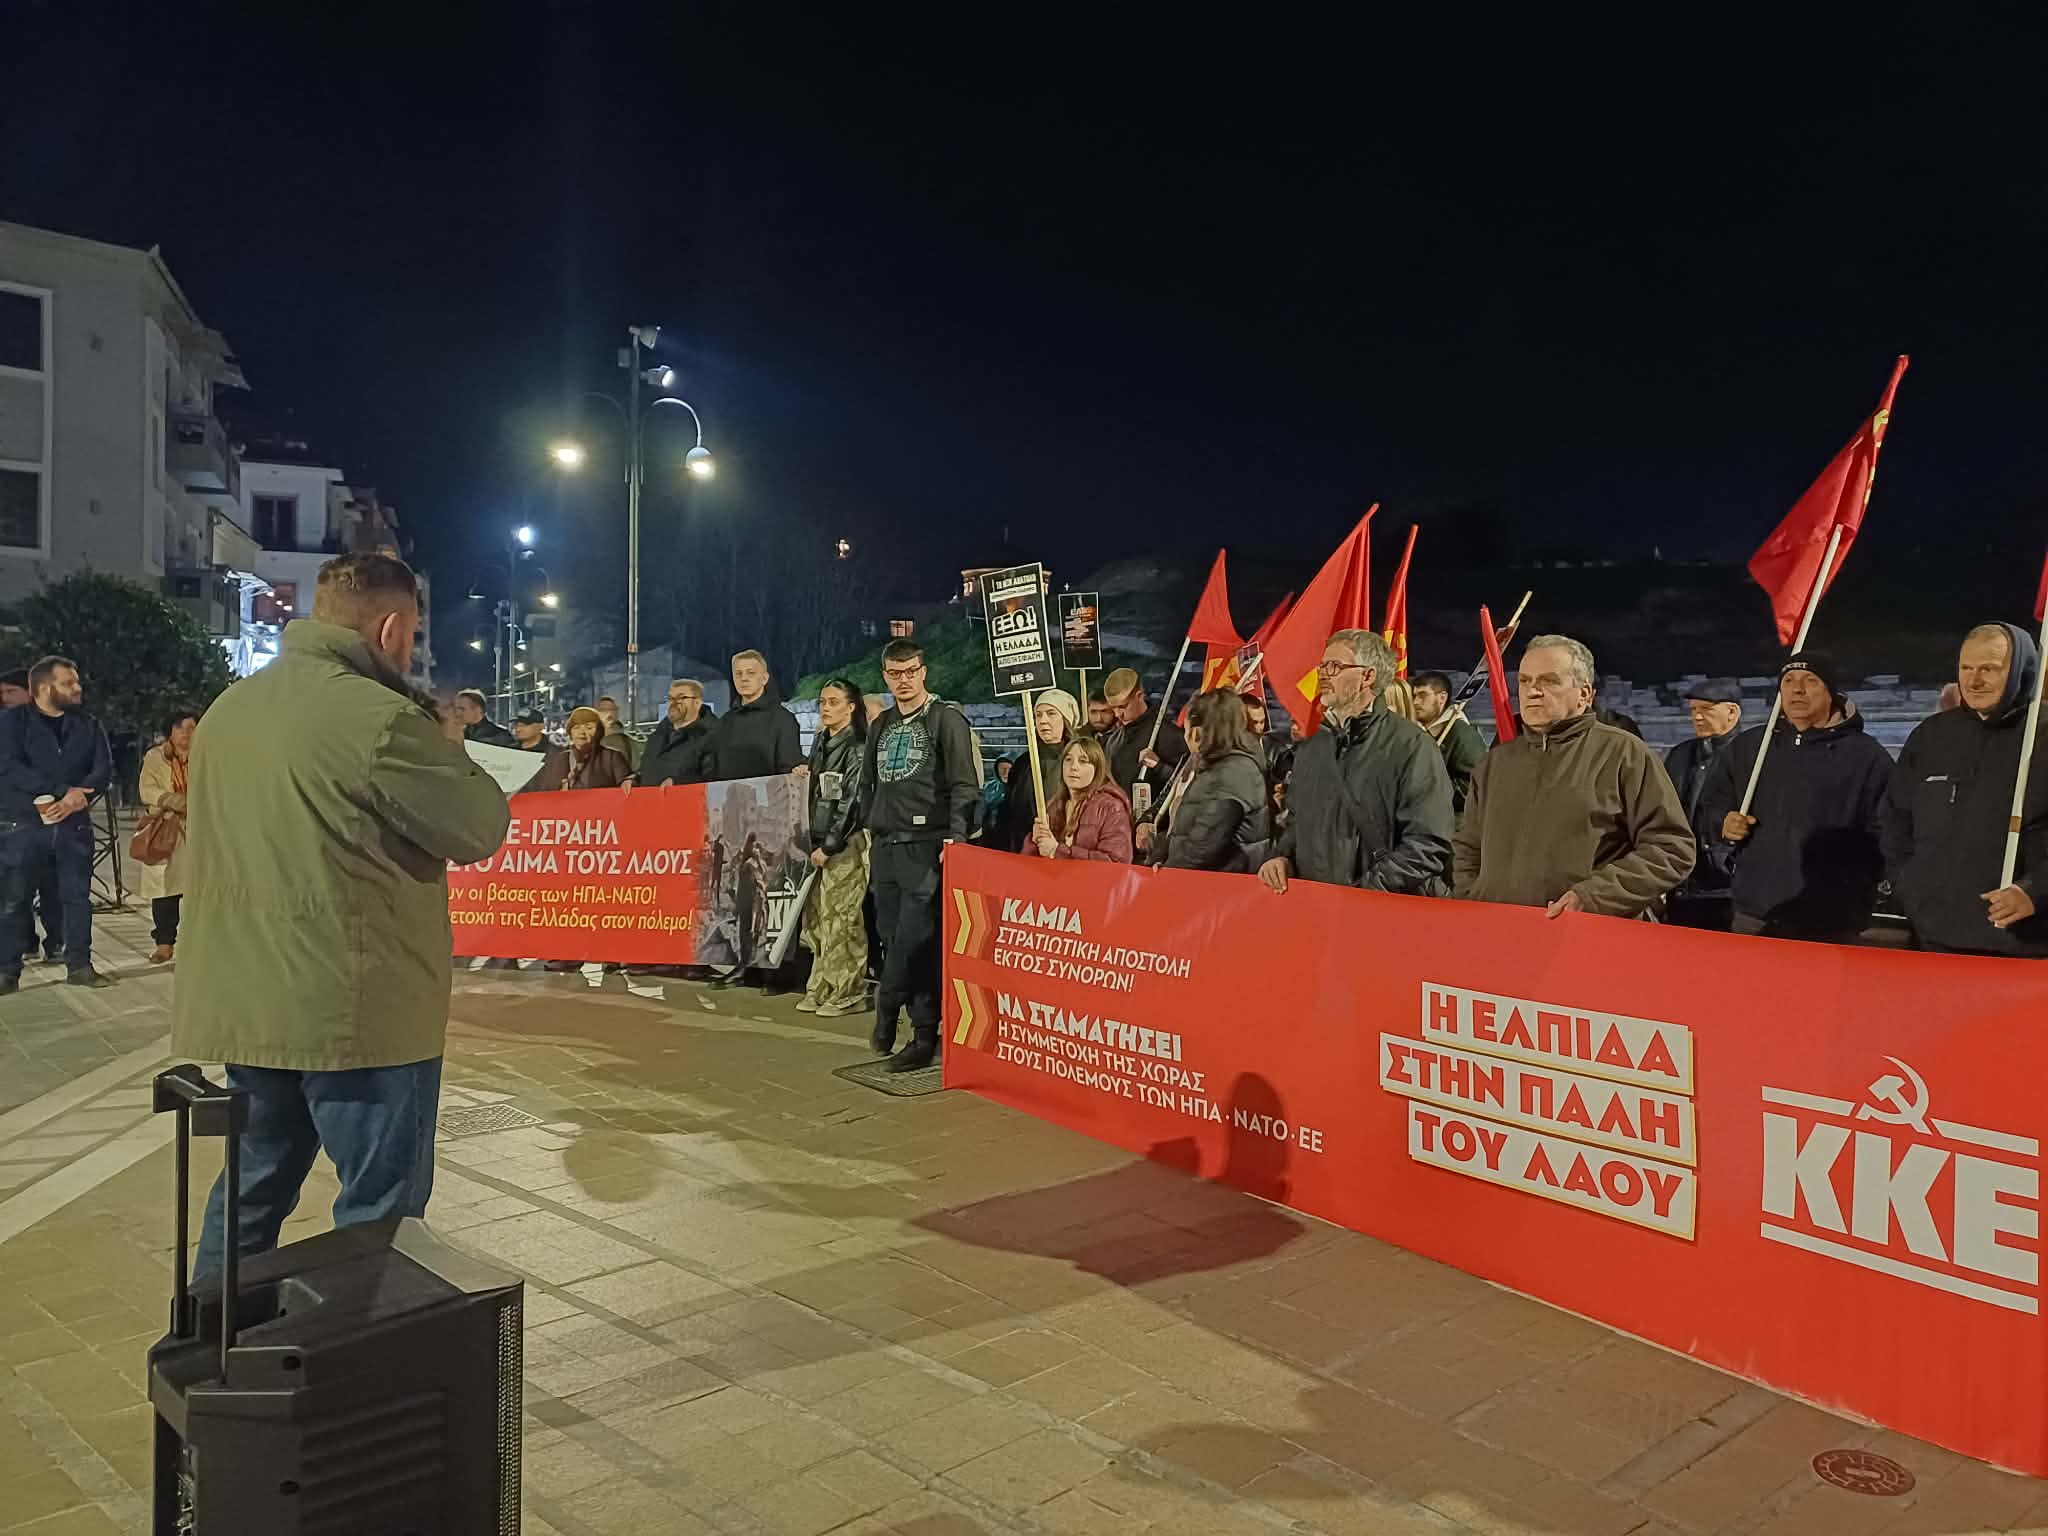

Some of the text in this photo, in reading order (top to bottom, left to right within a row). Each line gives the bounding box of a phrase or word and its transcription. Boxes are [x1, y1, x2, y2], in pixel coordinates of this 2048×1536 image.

[995, 606, 1036, 636] ΕΞΩ!
[996, 637, 1040, 652] Η ΕΛΛΑΔΑ
[504, 819, 619, 845] Ε-ΙΣΡΑΗΛ
[499, 850, 558, 874] ΑΙΜΑ
[565, 850, 622, 874] ΤΟΥΣ
[625, 850, 693, 875] ΛΑΟΥΣ
[468, 887, 483, 901] οι
[487, 883, 537, 905] βάσεις
[540, 889, 569, 903] των
[573, 886, 657, 905] ΗΠΑ-ΝΑΤΟ!
[1001, 897, 1082, 935] ΚΑΜΙΑ
[448, 908, 693, 936] ετοχή της Ελλάδας στον πόλεμο!
[994, 948, 1136, 993] ΕΚΤΟΣ ΣΥΝΟΡΩΝ!
[996, 926, 1191, 979] ΣΤΡΑΤΙΩΤΙΚΗ ΑΠΟΣΤΟΛΗ
[997, 991, 1183, 1062] ΝΑ ΣΤΑΜΑΤΗΣΕΙ
[1429, 990, 1681, 1079] Η ΕΛΠΙΔΑ
[996, 1041, 1042, 1071] ΣΤΟΥΣ
[1045, 1055, 1134, 1099] ΠΟΛΕΜΟΥΣ
[1136, 1082, 1176, 1111] ΤΩΝ
[998, 1020, 1206, 1094] Η ΣΥΜΜΕΤΟΧΗ ΤΗΣ ΧΩΡΑΣ
[1385, 1042, 1681, 1149] ΣΤΗΝ ΠΑΛΗ
[1414, 1110, 1684, 1218] ΤΟΥ ΛΑΟΥ
[1761, 1111, 2039, 1286] ΚΚΕ
